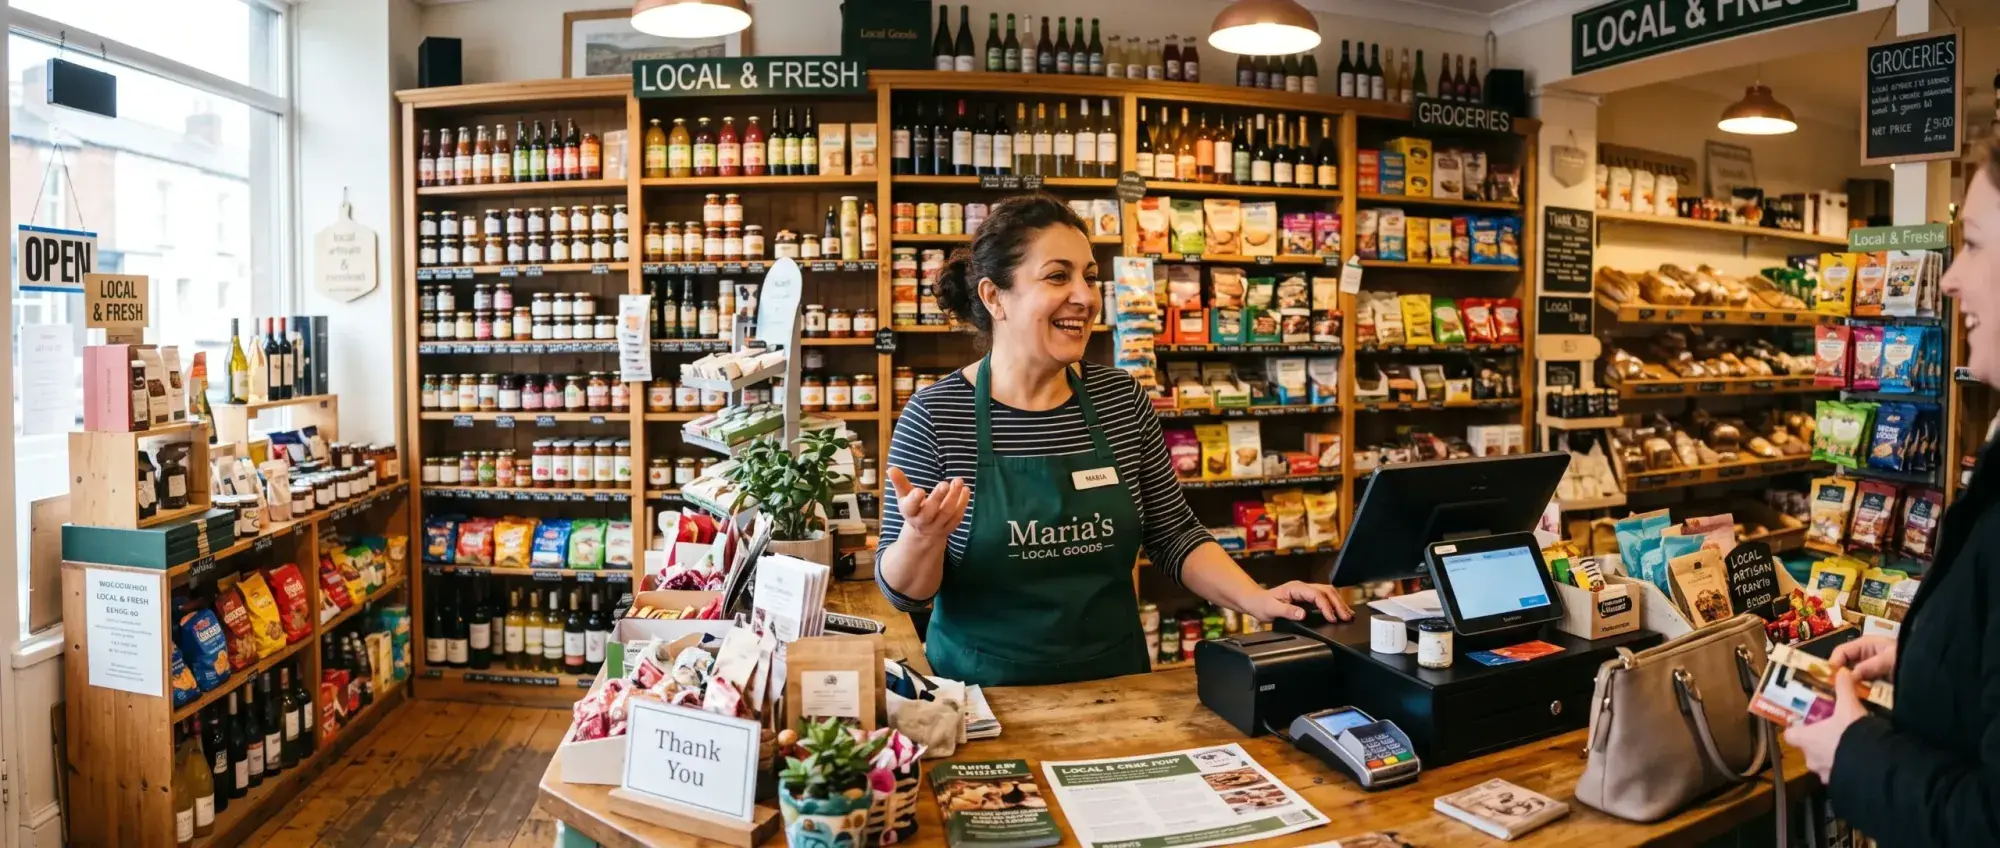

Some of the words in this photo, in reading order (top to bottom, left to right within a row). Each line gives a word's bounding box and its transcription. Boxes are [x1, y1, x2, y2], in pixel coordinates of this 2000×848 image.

[860, 28, 886, 39] Local
[888, 28, 917, 40] Goods
[1581, 0, 1677, 57] LOCAL
[1685, 0, 1706, 29] &
[1870, 41, 1955, 75] GROCERIES
[641, 63, 731, 91] LOCAL
[740, 61, 758, 89] &
[768, 61, 858, 88] FRESH
[1418, 102, 1509, 132] GROCERIES
[1890, 123, 1912, 135] PRICE
[1854, 231, 1886, 246] Local
[1889, 230, 1900, 245] &
[25, 236, 91, 283] OPEN
[100, 280, 138, 299] LOCAL
[92, 303, 103, 322] &
[106, 303, 143, 321] FRESH
[1085, 473, 1107, 481] MARIA
[1007, 512, 1115, 546] Maria's
[1022, 548, 1060, 560] LOCAL
[1062, 542, 1102, 556] GOODS
[1730, 549, 1763, 569] LOCAL
[1733, 562, 1772, 584] ARTISAN
[96, 592, 117, 601] LOCAL
[127, 596, 149, 605] FRESH
[655, 728, 721, 762] Thank
[667, 759, 704, 787] You
